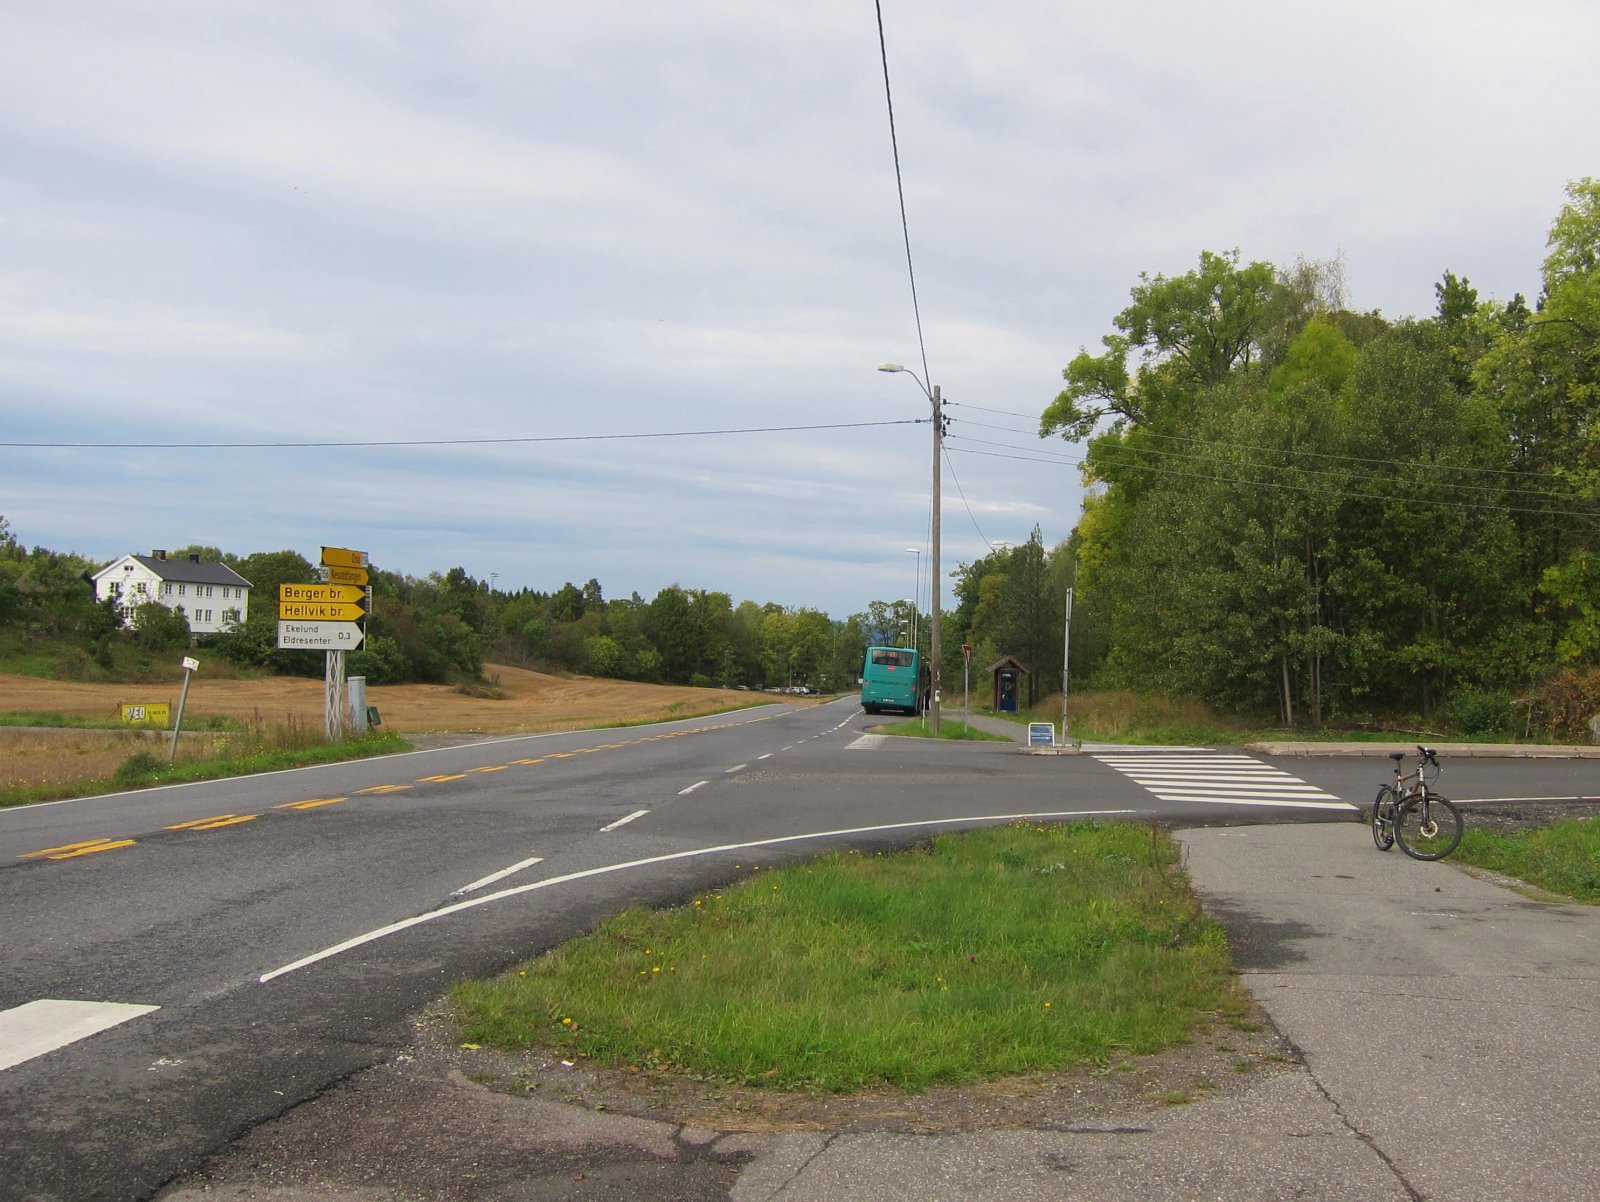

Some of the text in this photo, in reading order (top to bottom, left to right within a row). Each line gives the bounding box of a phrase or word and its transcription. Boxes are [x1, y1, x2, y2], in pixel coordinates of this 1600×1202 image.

[284, 587, 344, 600] Berger br.
[284, 606, 345, 617] Hellvik br.
[285, 624, 319, 633] Ekelund
[283, 636, 332, 645] Eldresenter
